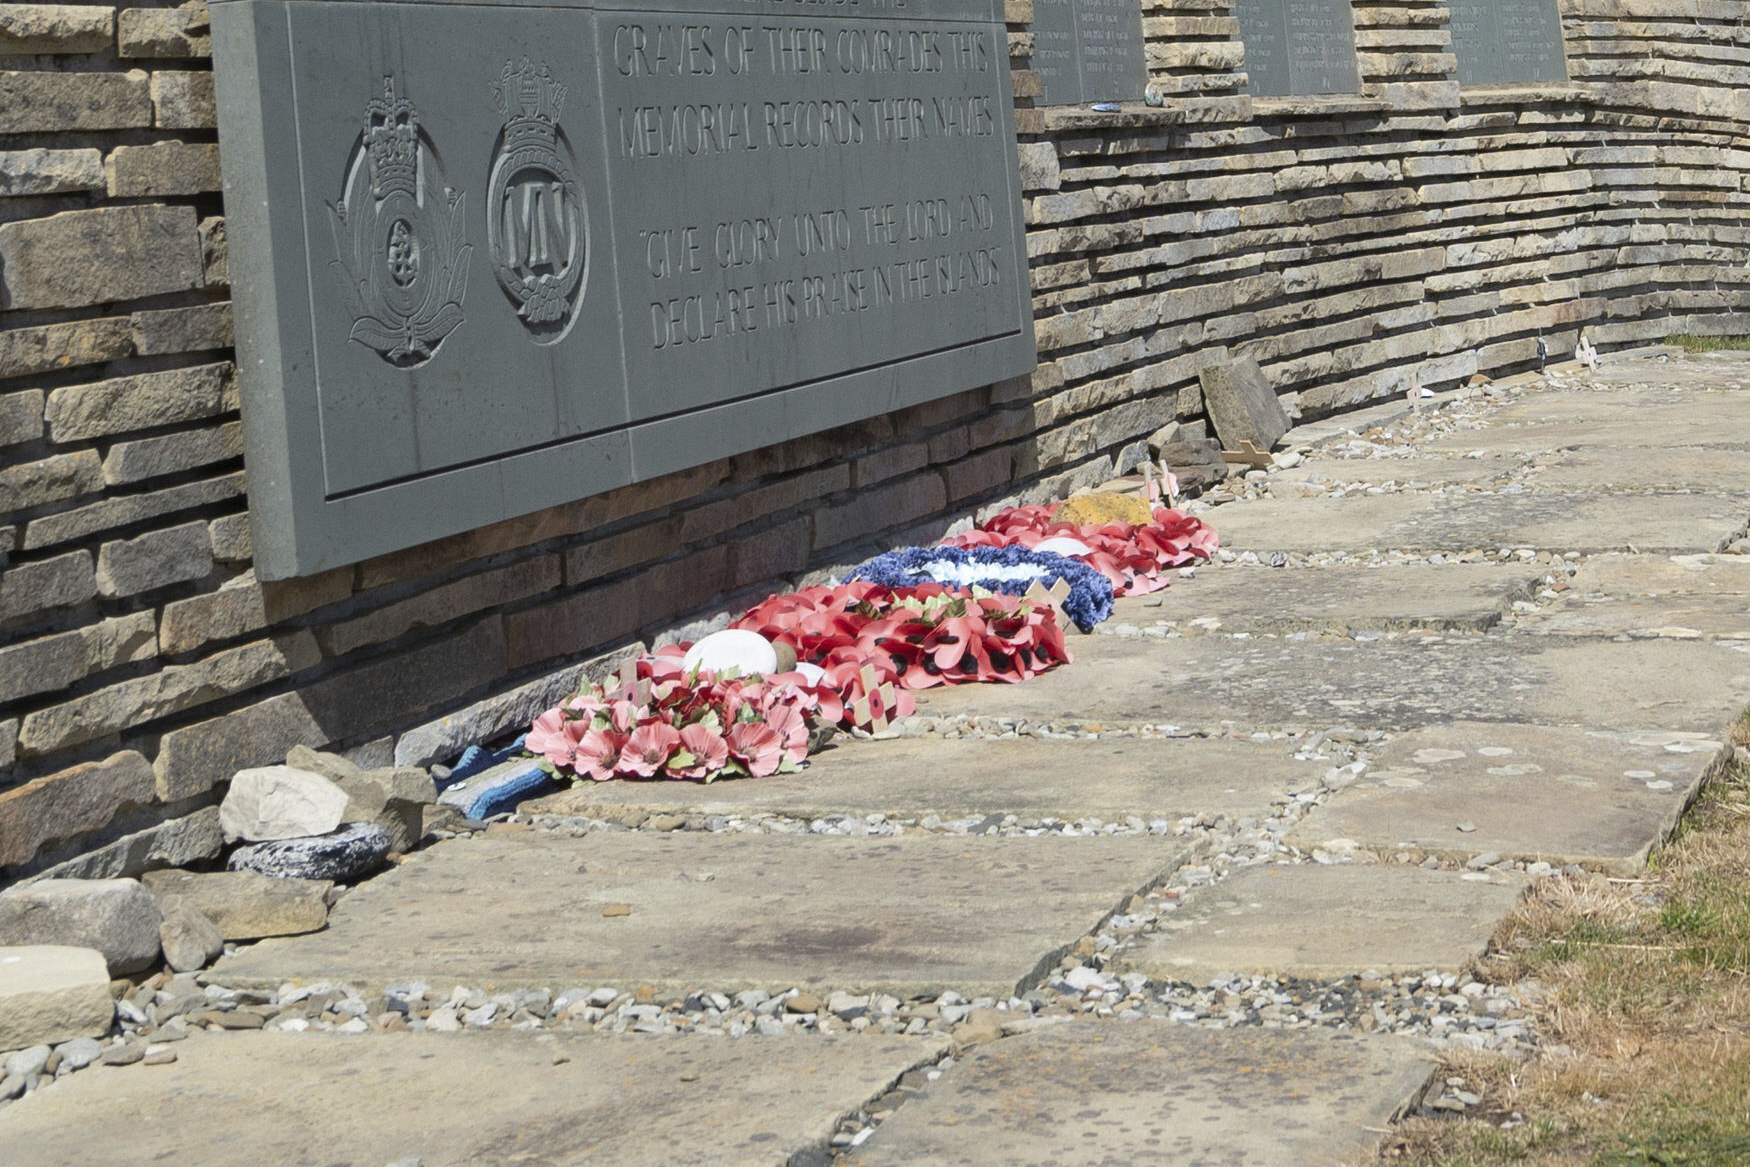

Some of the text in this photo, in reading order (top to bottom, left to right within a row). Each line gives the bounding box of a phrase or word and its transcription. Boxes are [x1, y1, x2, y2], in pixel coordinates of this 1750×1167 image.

[614, 24, 989, 78] GRAVES OF THEIR COMRADES THIS
[618, 95, 994, 160] MEMORIAL RECORDS THEIR NAMES
[715, 216, 782, 269] GLORY
[794, 208, 850, 257] UNTO
[859, 203, 898, 246] THE
[905, 197, 951, 243] LORD
[959, 193, 994, 233] AND
[650, 286, 757, 352] DECLARE
[764, 279, 799, 329] HIS
[802, 268, 869, 322] PRAISE
[873, 264, 893, 309] IN
[894, 257, 932, 304] THE
